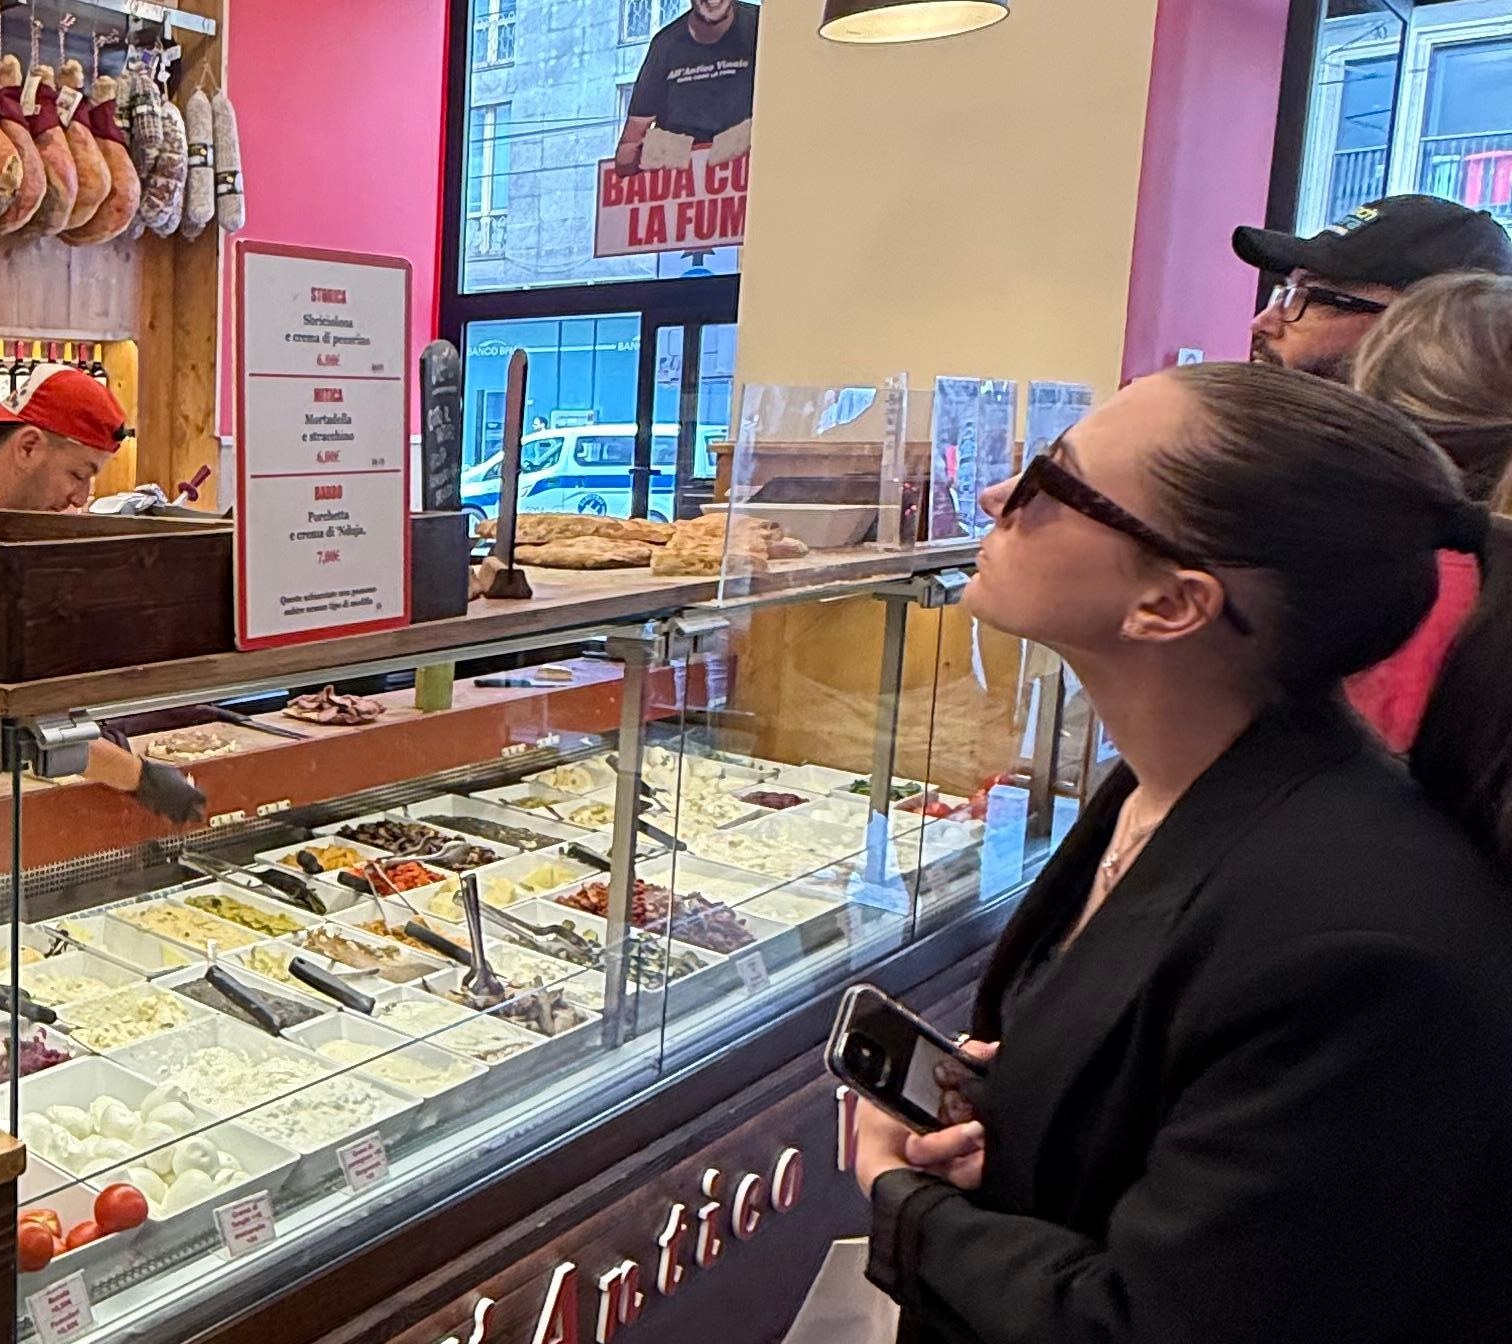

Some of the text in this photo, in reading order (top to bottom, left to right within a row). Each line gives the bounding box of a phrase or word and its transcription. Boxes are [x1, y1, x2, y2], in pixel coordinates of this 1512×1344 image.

[602, 165, 696, 208] BADA
[628, 203, 667, 246] LA
[305, 413, 352, 425] Mortadella
